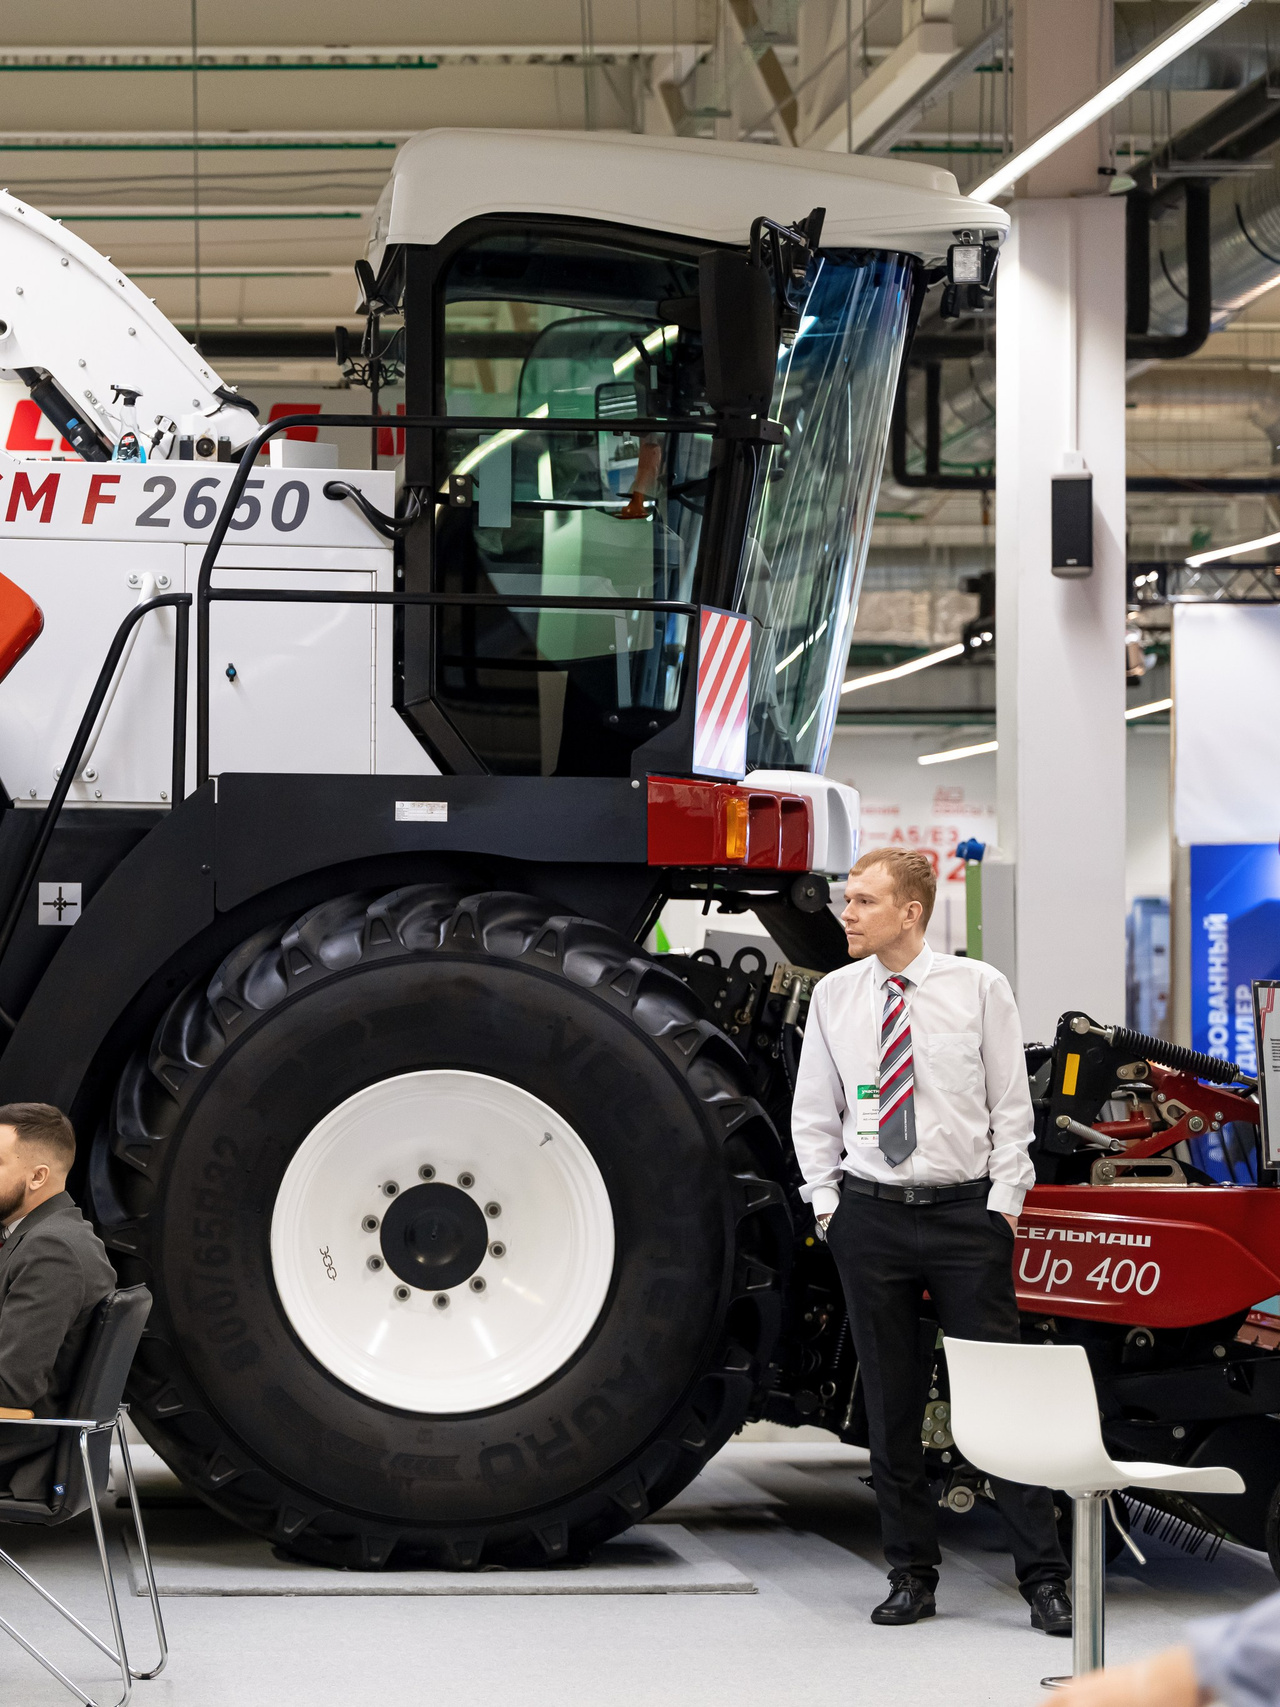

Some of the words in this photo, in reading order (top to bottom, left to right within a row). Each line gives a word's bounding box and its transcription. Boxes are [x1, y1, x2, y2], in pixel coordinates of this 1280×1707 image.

[82, 474, 122, 525] F
[135, 475, 310, 533] 2650
[1235, 984, 1257, 1073] ДИЛЕР
[1016, 1226, 1151, 1247] СЕЛЬМАШ
[1018, 1248, 1073, 1293] Up
[1085, 1257, 1161, 1296] 400
